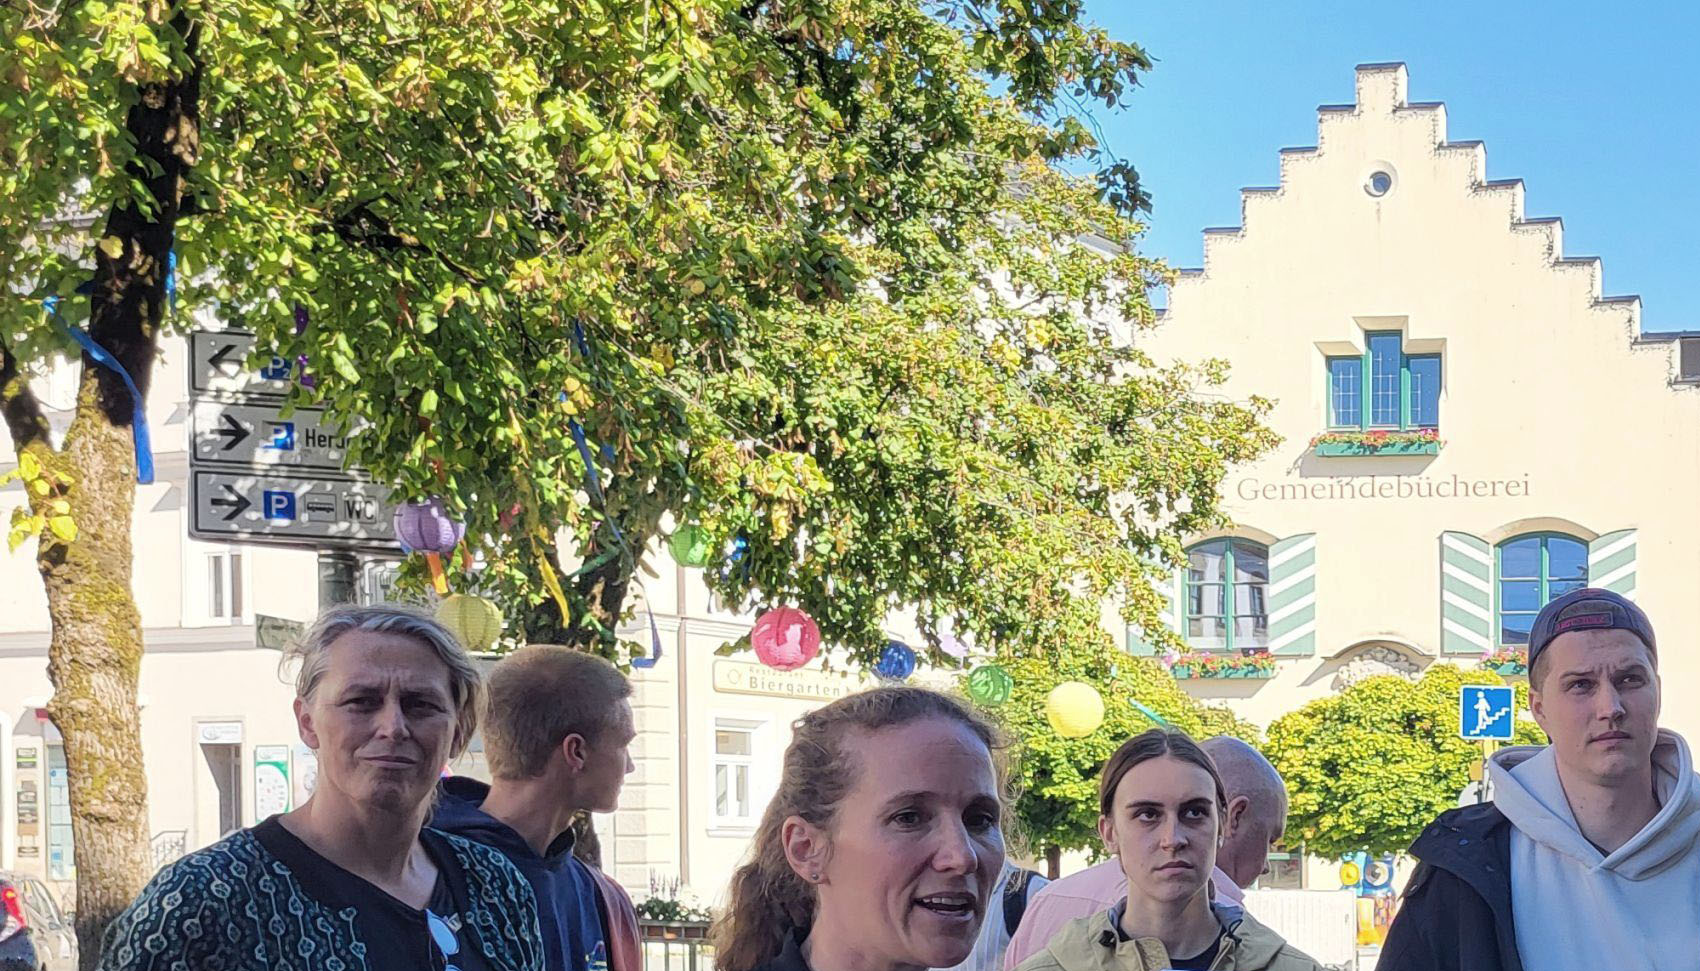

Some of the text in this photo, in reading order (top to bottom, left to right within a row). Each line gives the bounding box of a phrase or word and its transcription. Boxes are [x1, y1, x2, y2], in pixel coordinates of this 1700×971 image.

[1237, 473, 1530, 501] Gemeindebücherei
[344, 499, 376, 520] WC
[749, 676, 840, 696] Biergarten
